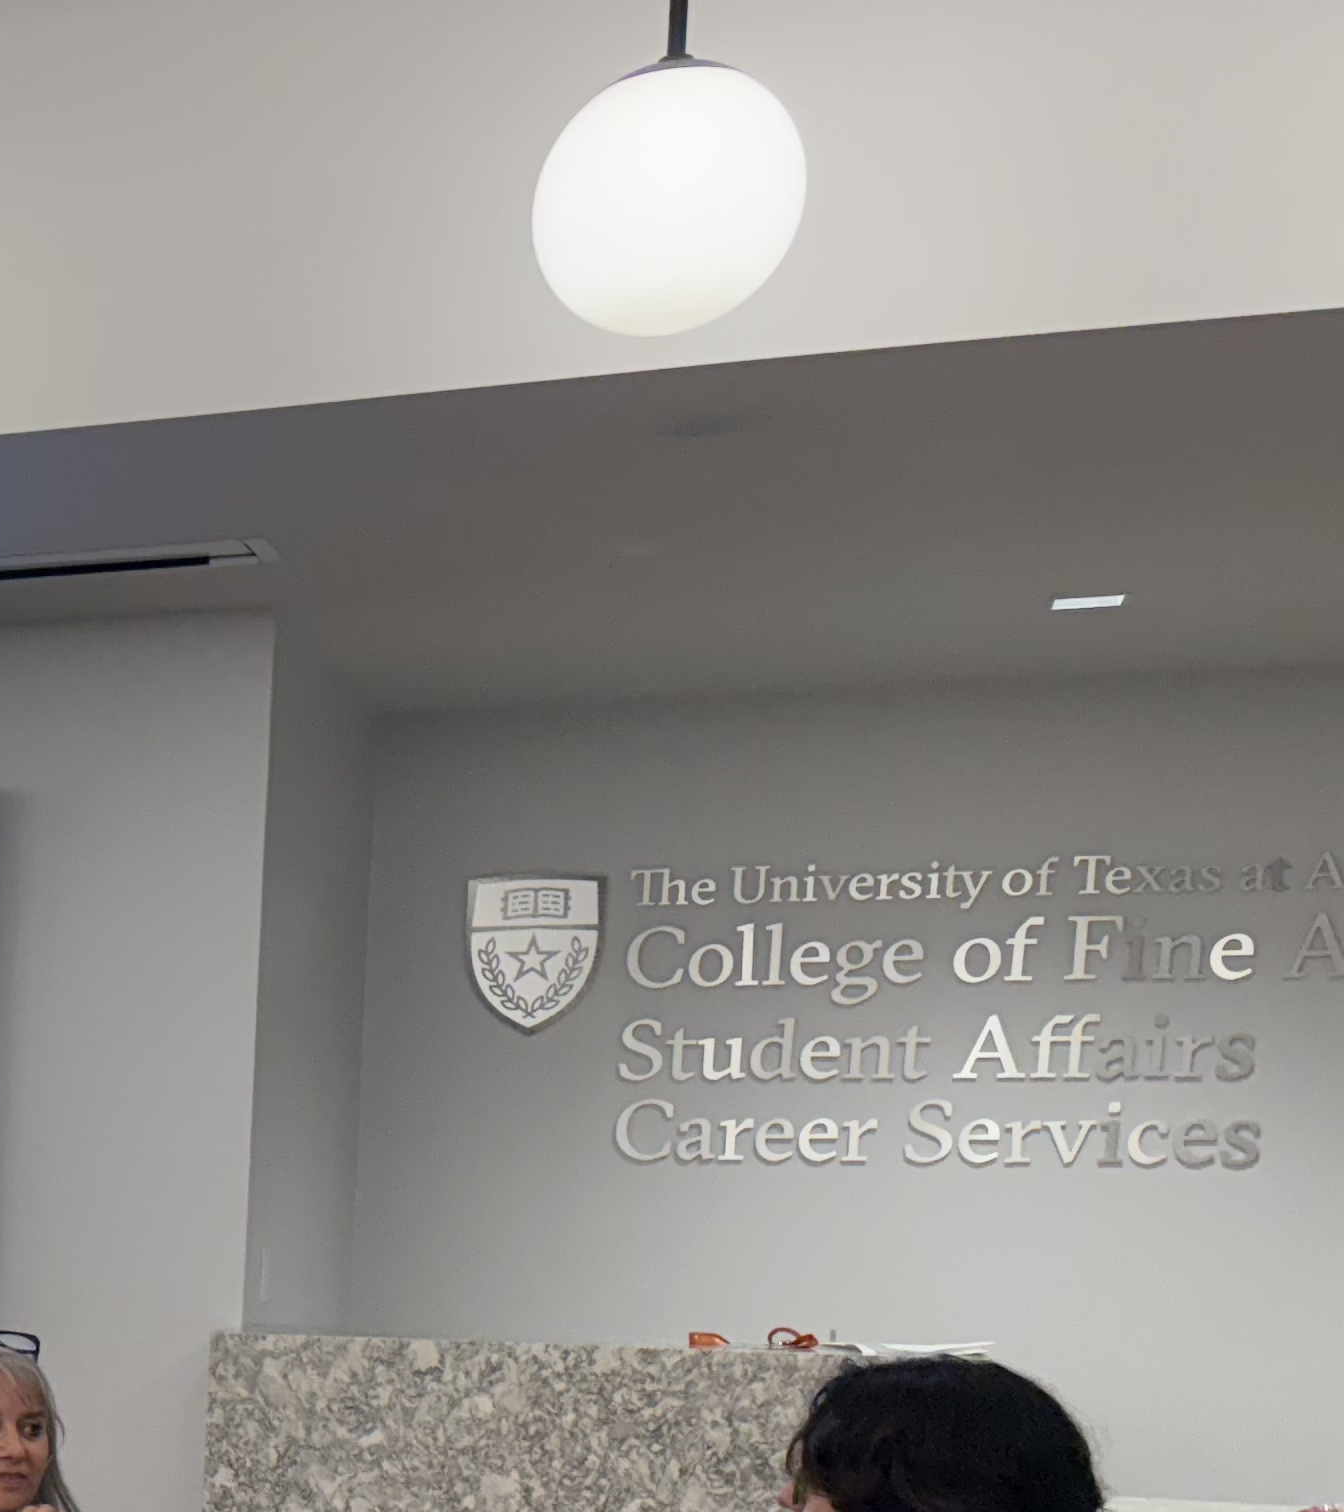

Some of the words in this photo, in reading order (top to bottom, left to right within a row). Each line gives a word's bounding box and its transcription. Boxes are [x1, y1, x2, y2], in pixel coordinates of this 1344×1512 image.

[631, 867, 717, 906] The
[730, 860, 993, 909] University
[1002, 855, 1059, 896] of
[1073, 855, 1222, 896] Texas
[1240, 856, 1294, 893] at
[626, 922, 925, 1006] College
[952, 915, 1045, 984] of
[1063, 914, 1255, 982] Fine
[618, 1017, 932, 1082] Student
[952, 1012, 1257, 1083] Affairs
[615, 1098, 879, 1164] Career
[903, 1097, 1262, 1170] Services
